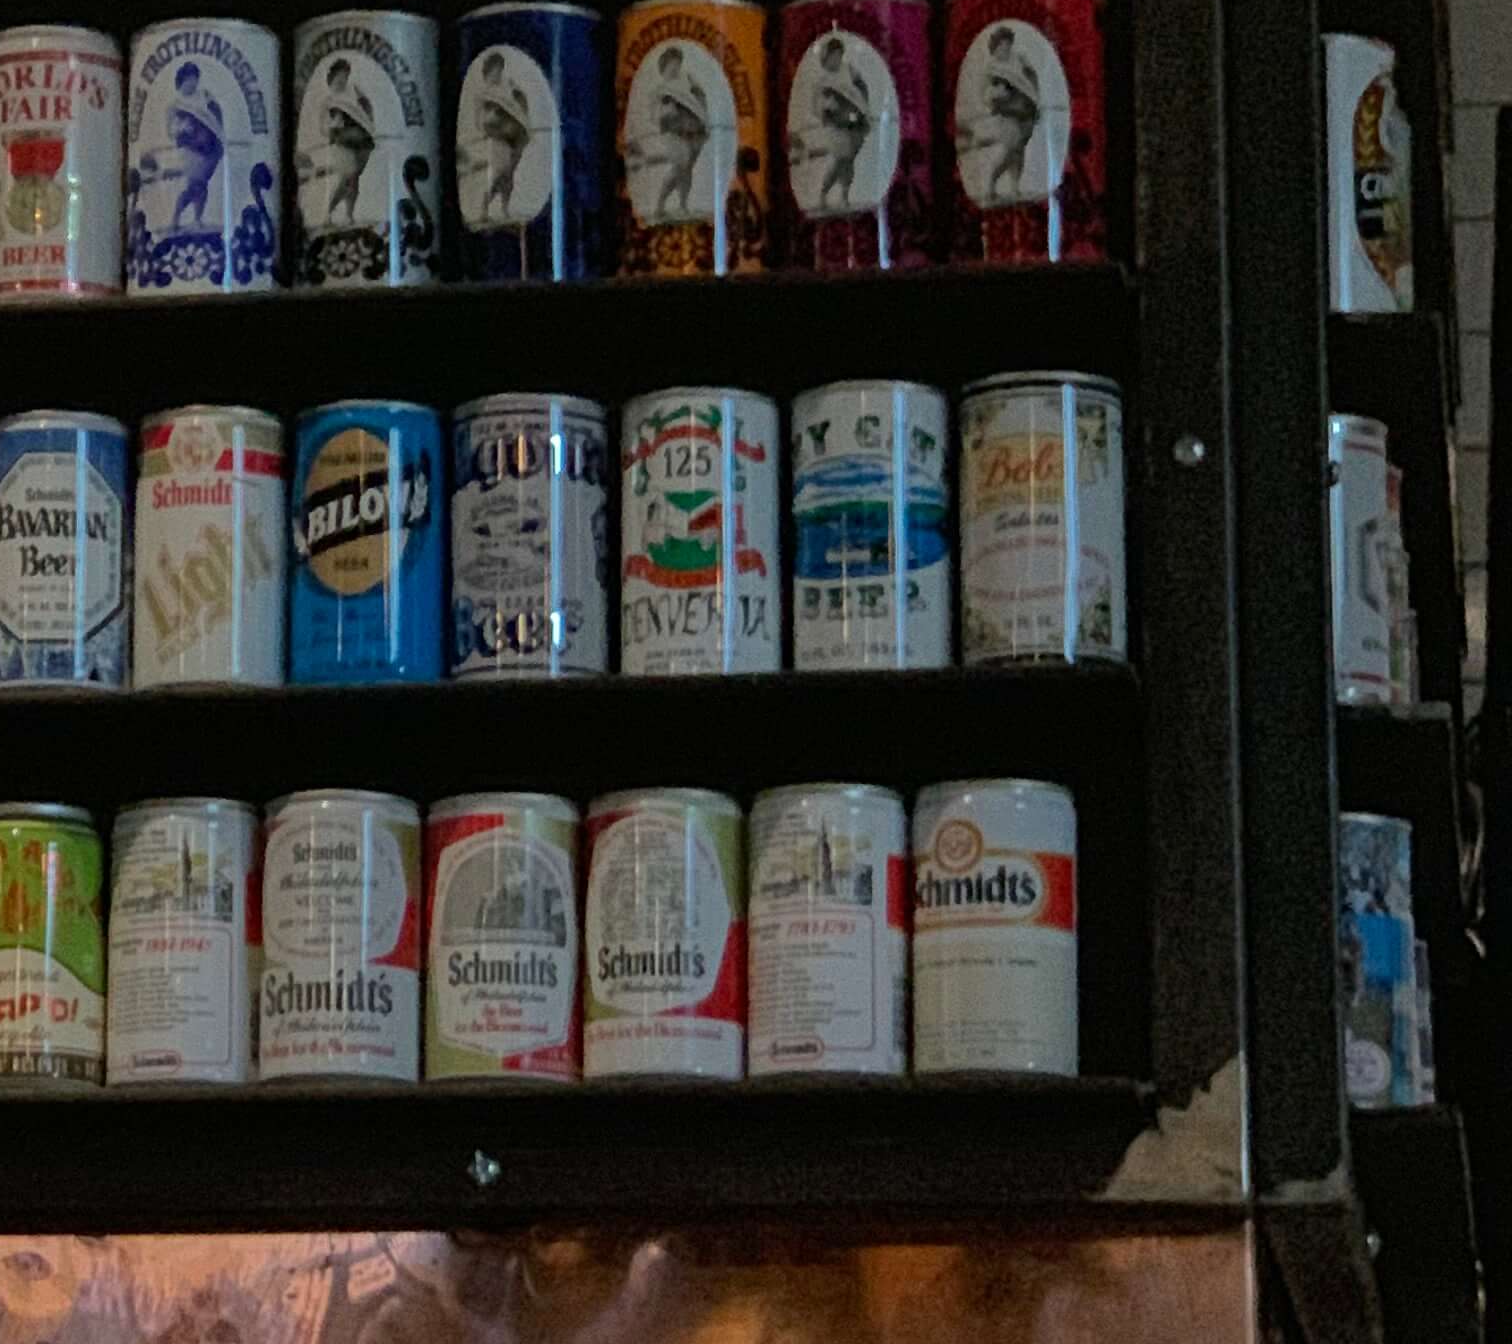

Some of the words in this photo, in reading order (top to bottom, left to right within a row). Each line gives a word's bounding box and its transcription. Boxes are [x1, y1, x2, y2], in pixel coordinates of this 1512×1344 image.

[0, 94, 76, 124] FAIR
[1, 244, 67, 266] BEER
[662, 443, 714, 478] 125
[20, 543, 77, 578] Beer
[448, 951, 558, 989] Schmidt's
[597, 944, 704, 981] Schmidt's
[265, 969, 393, 1017] Schmidt's
